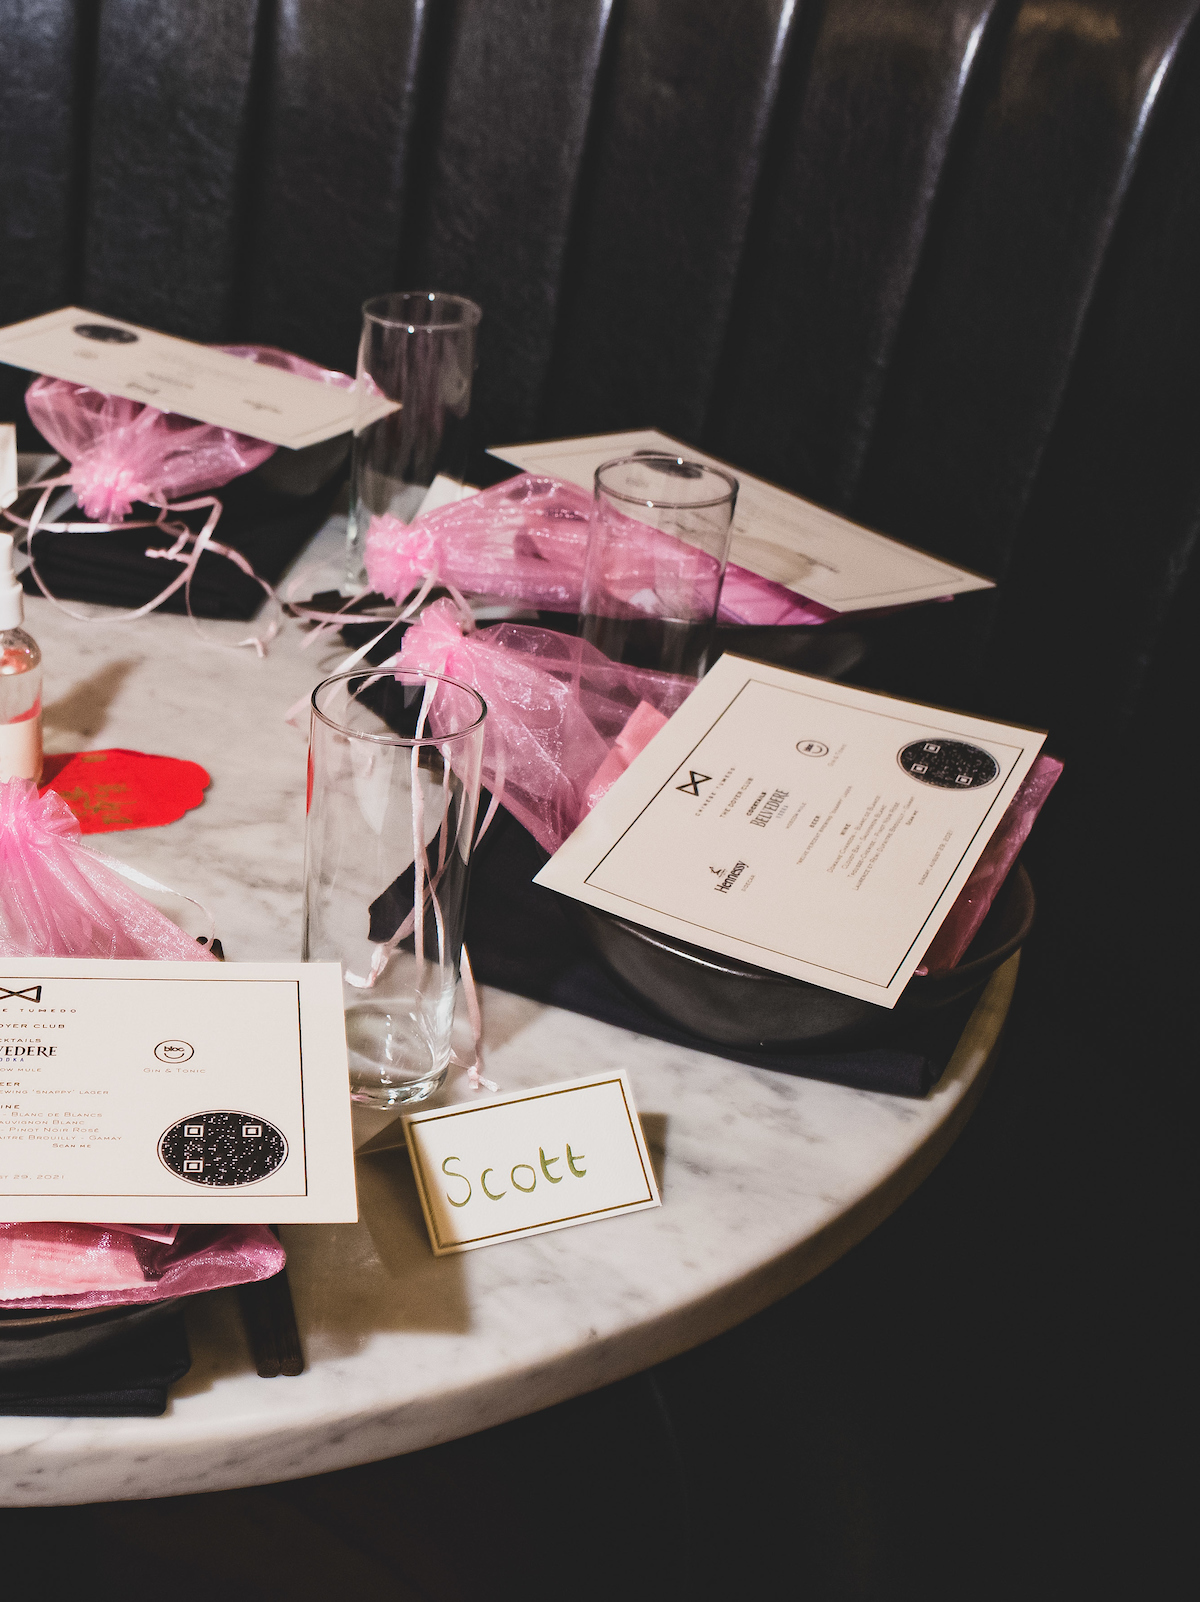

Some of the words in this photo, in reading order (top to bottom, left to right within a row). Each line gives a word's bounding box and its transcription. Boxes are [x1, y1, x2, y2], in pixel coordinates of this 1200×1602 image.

[750, 789, 789, 827] BELVEDERE
[714, 860, 749, 894] Hennessy
[441, 1143, 587, 1207] Scott
